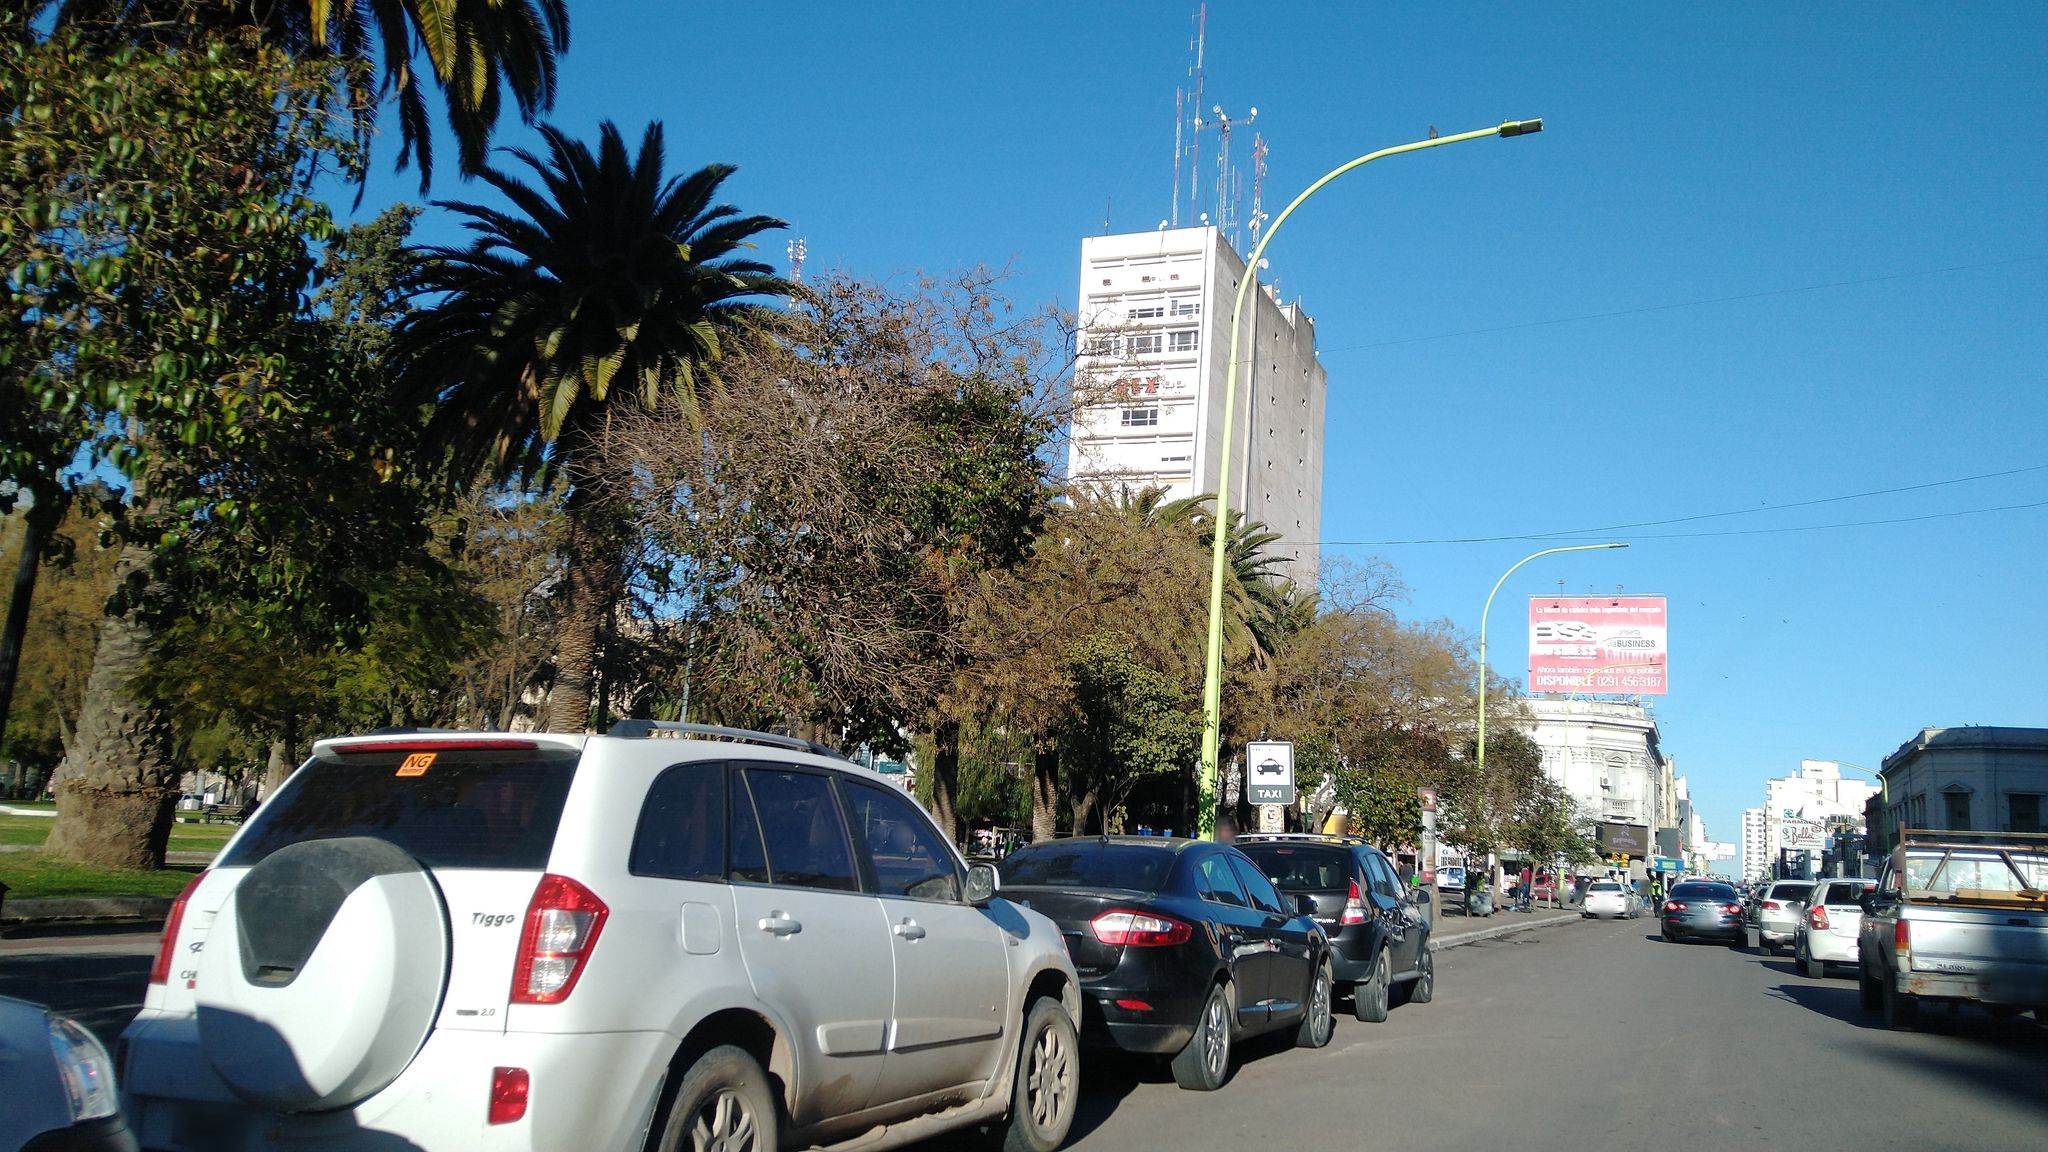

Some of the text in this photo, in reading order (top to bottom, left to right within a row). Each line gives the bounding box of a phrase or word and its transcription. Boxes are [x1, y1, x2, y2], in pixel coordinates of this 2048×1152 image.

[1536, 675, 1662, 687] DISPONIBLE 0291 456-3187
[404, 755, 431, 768] NG
[1257, 789, 1282, 799] TAXI
[472, 912, 515, 927] Tiggo
[480, 1008, 496, 1016] 2.0
